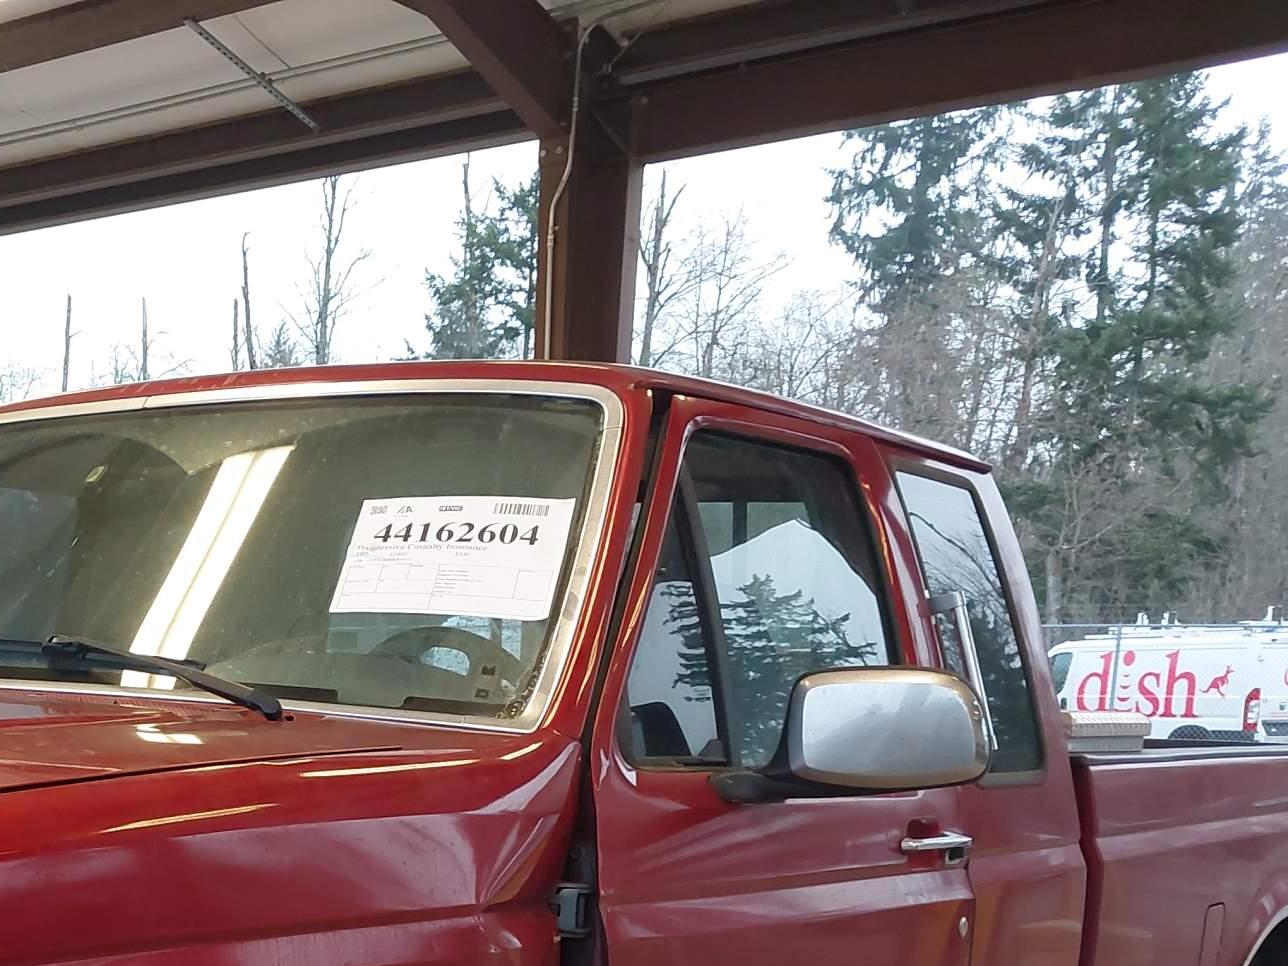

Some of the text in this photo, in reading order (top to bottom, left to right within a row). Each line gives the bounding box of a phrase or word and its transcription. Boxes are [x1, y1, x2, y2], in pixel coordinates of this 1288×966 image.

[373, 521, 539, 546] 44162604
[407, 542, 442, 552] Casualty
[446, 543, 488, 551] Insurance
[1076, 649, 1199, 718] dish
